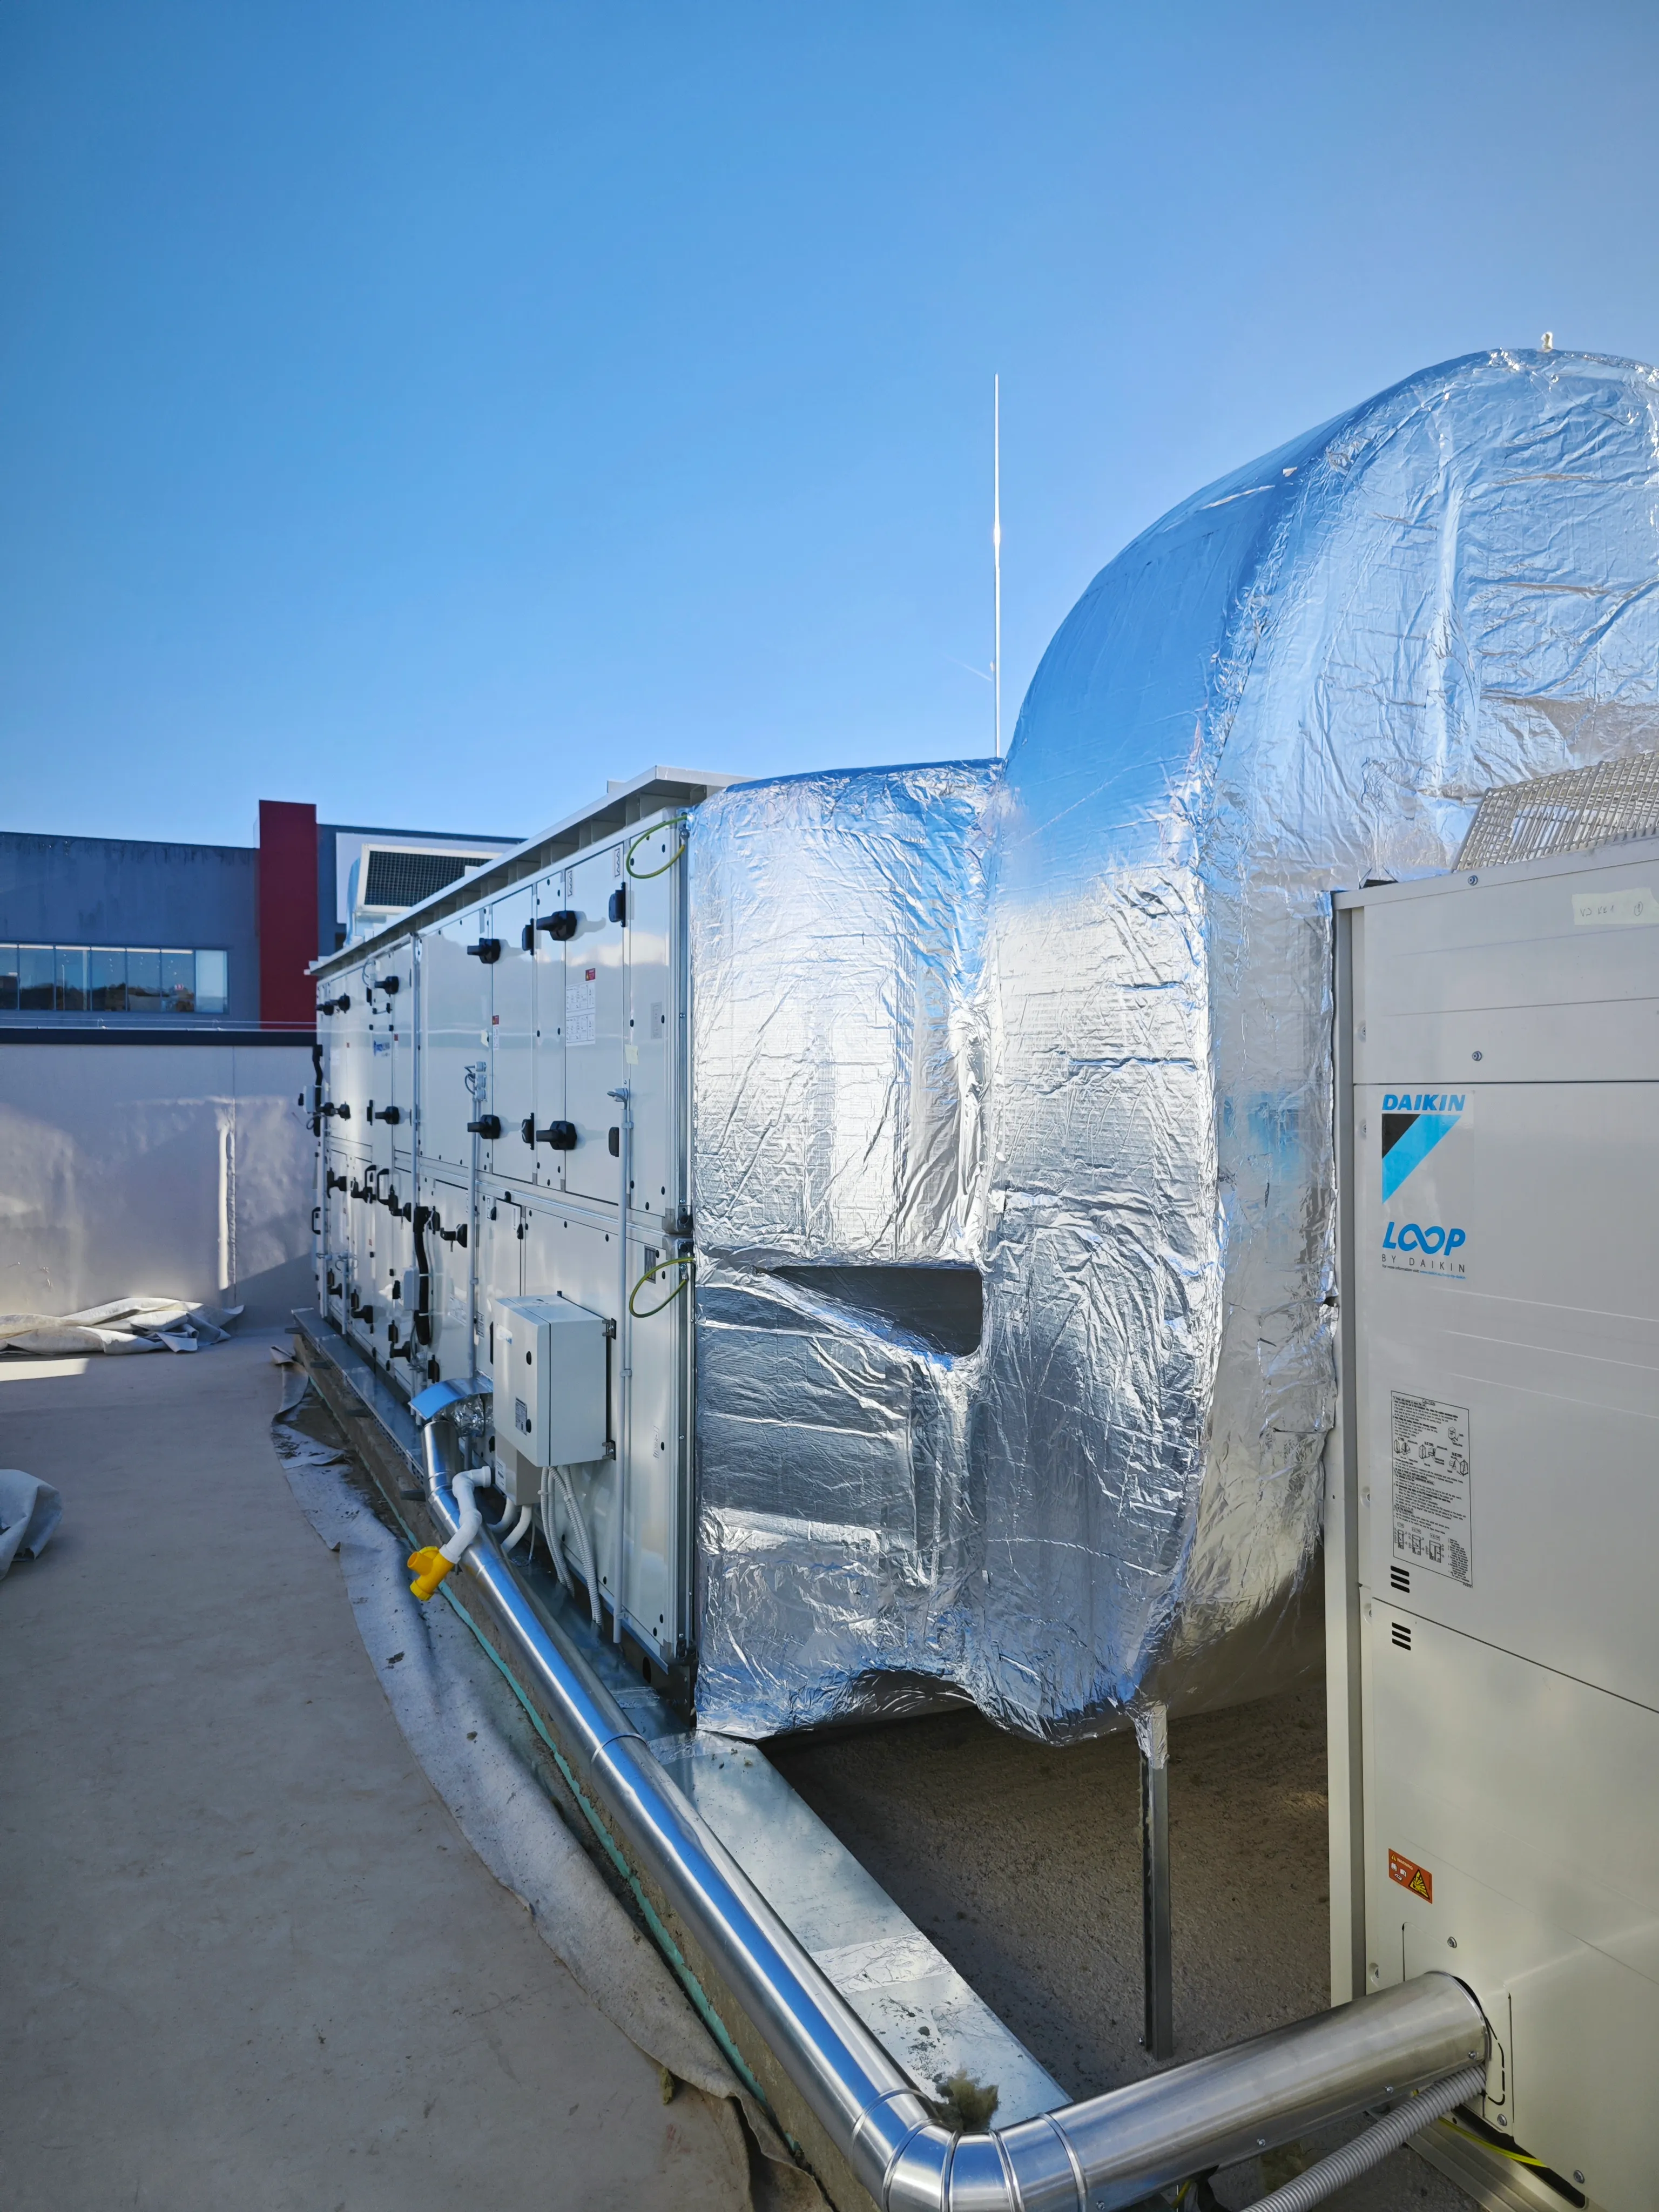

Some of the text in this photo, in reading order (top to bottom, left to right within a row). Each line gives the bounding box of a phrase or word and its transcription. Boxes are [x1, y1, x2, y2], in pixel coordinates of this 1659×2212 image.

[1382, 1094, 1466, 1111] DAIKIN
[1382, 1222, 1466, 1256] LOOP
[1381, 1253, 1465, 1273] BY DAIKIN
[1397, 1857, 1413, 1870] WARNING
